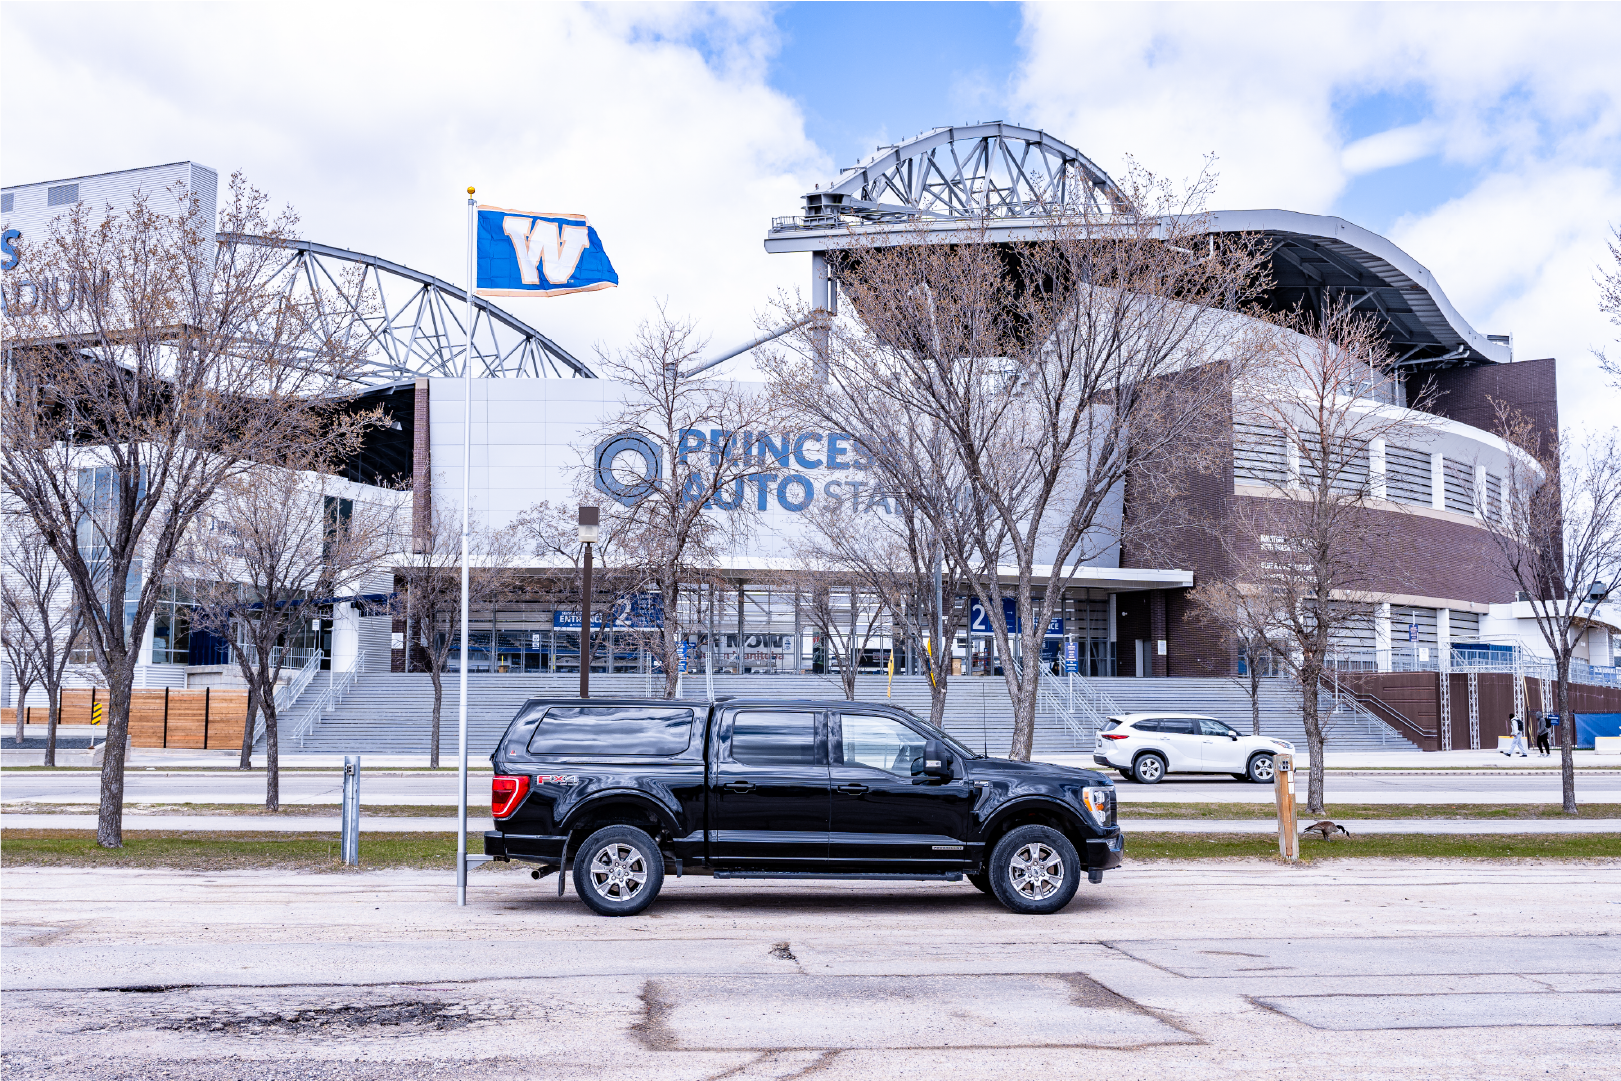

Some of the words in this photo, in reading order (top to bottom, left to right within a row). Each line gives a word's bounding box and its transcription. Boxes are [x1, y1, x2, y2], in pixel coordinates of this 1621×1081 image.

[502, 216, 590, 285] W
[680, 473, 815, 512] AUTO
[972, 604, 986, 630] 2
[536, 774, 580, 786] FX4
